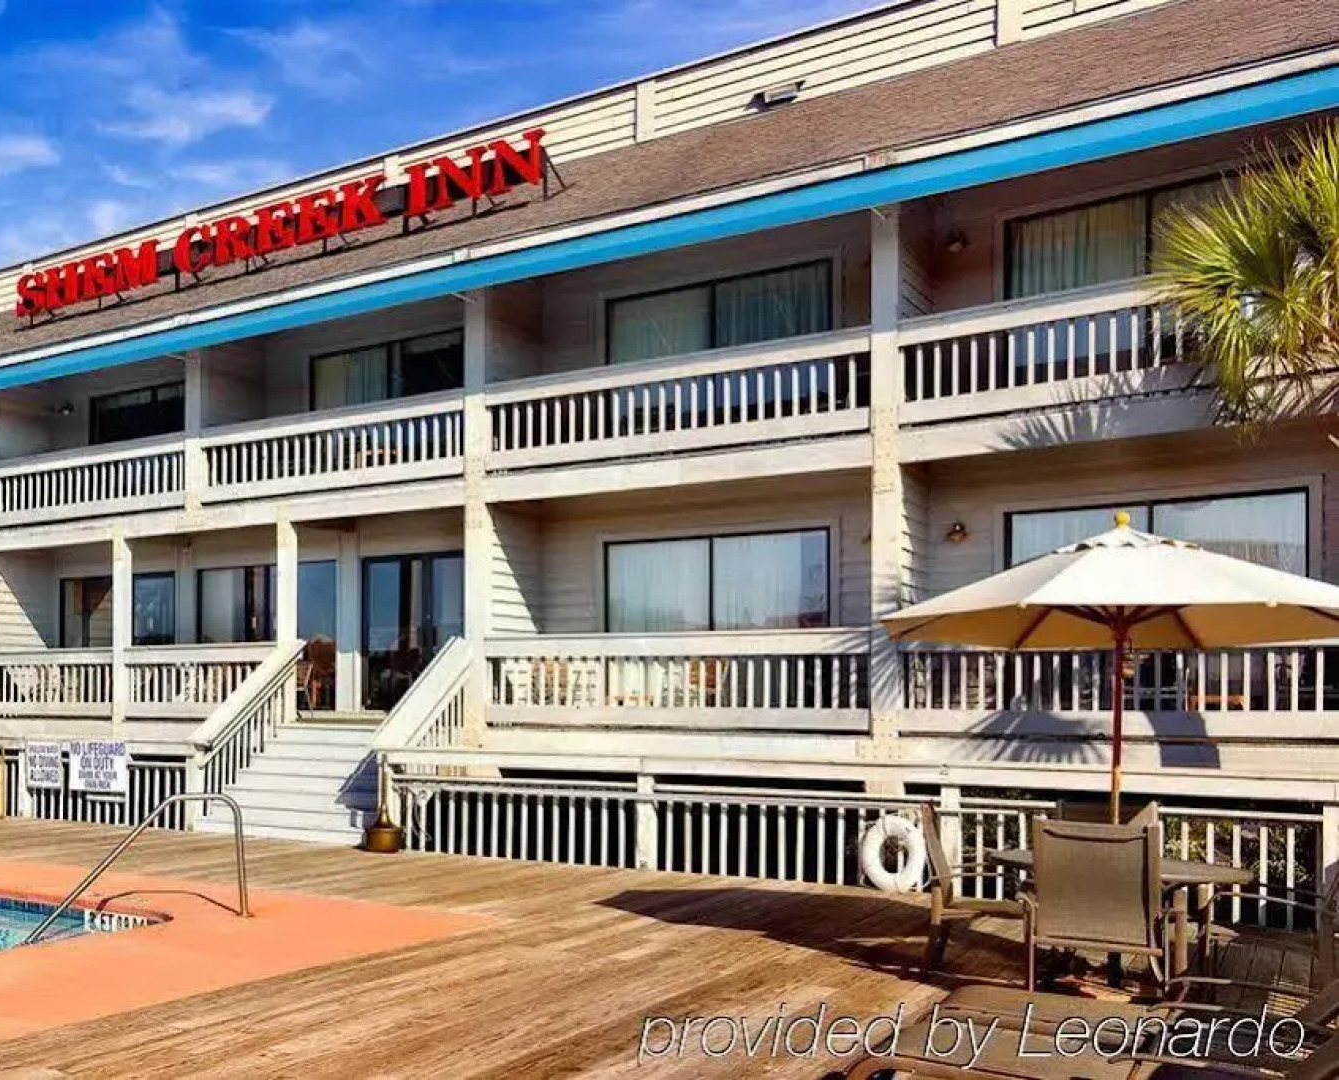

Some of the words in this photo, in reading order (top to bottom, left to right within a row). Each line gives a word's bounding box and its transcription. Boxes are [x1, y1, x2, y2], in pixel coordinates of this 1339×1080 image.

[15, 238, 162, 317] SHEM
[169, 174, 390, 275] CREEK
[404, 128, 546, 218] INN
[70, 741, 81, 756] NO
[82, 742, 125, 756] LIFEGUARD
[80, 756, 92, 770] ON
[93, 756, 114, 771] DUTY
